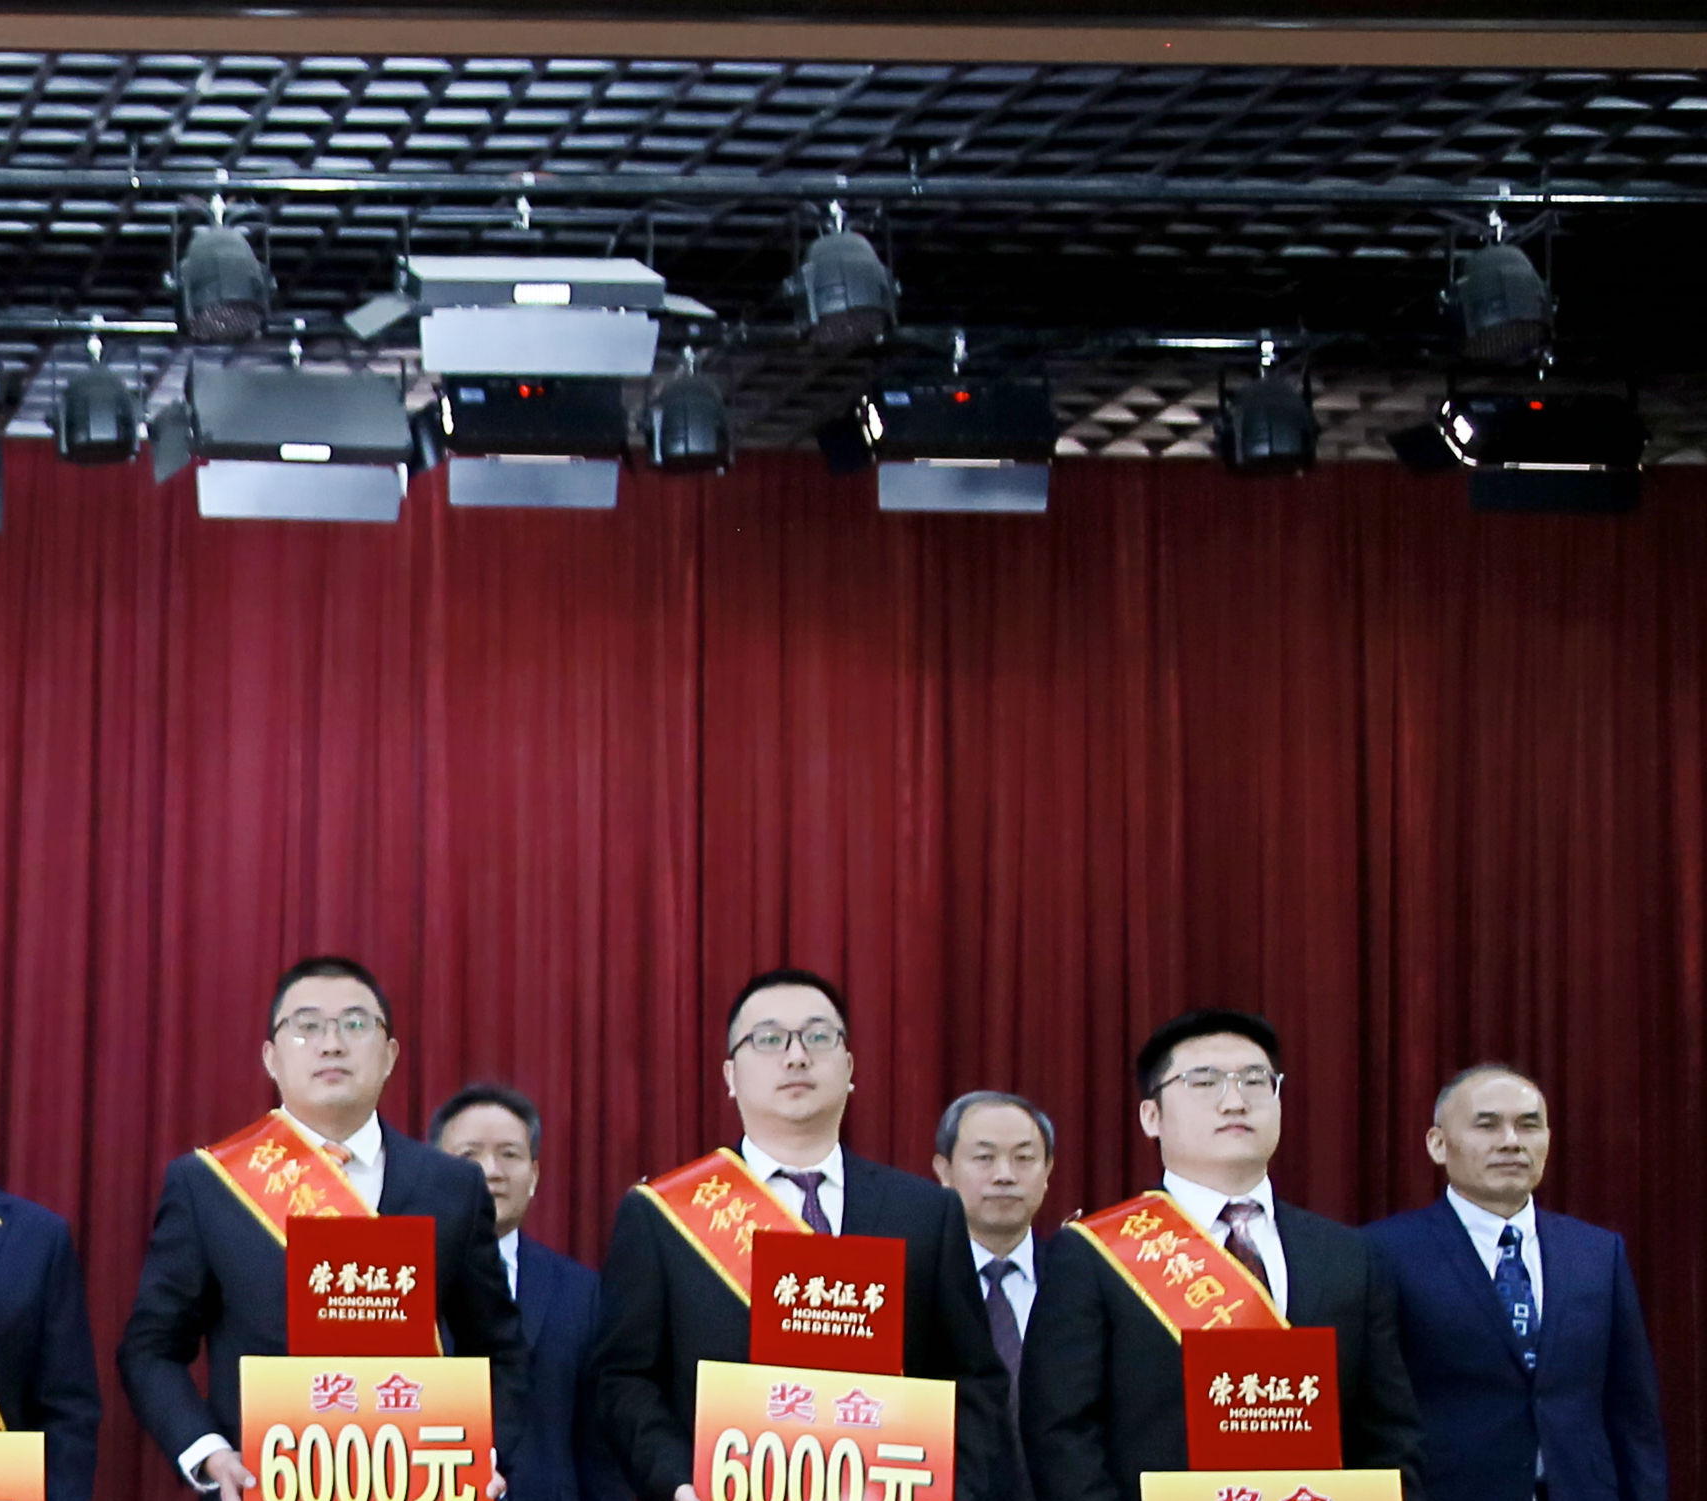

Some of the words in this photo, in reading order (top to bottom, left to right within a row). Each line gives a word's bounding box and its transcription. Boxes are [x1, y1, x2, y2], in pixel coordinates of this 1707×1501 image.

[309, 1261, 416, 1295] 荣誉证书
[328, 1296, 399, 1307] HONORARY
[774, 1273, 885, 1314] 荣誉证书
[318, 1308, 407, 1320] CREDENTIAL
[793, 1307, 866, 1324] HONORARY
[782, 1318, 874, 1338] CREDENTIAL
[310, 1371, 423, 1414] 奖金
[1209, 1372, 1319, 1406] 荣誉证书
[766, 1382, 885, 1427] 奖金
[1229, 1407, 1303, 1418] HONORARY
[1220, 1420, 1312, 1431] CREDENTIAL
